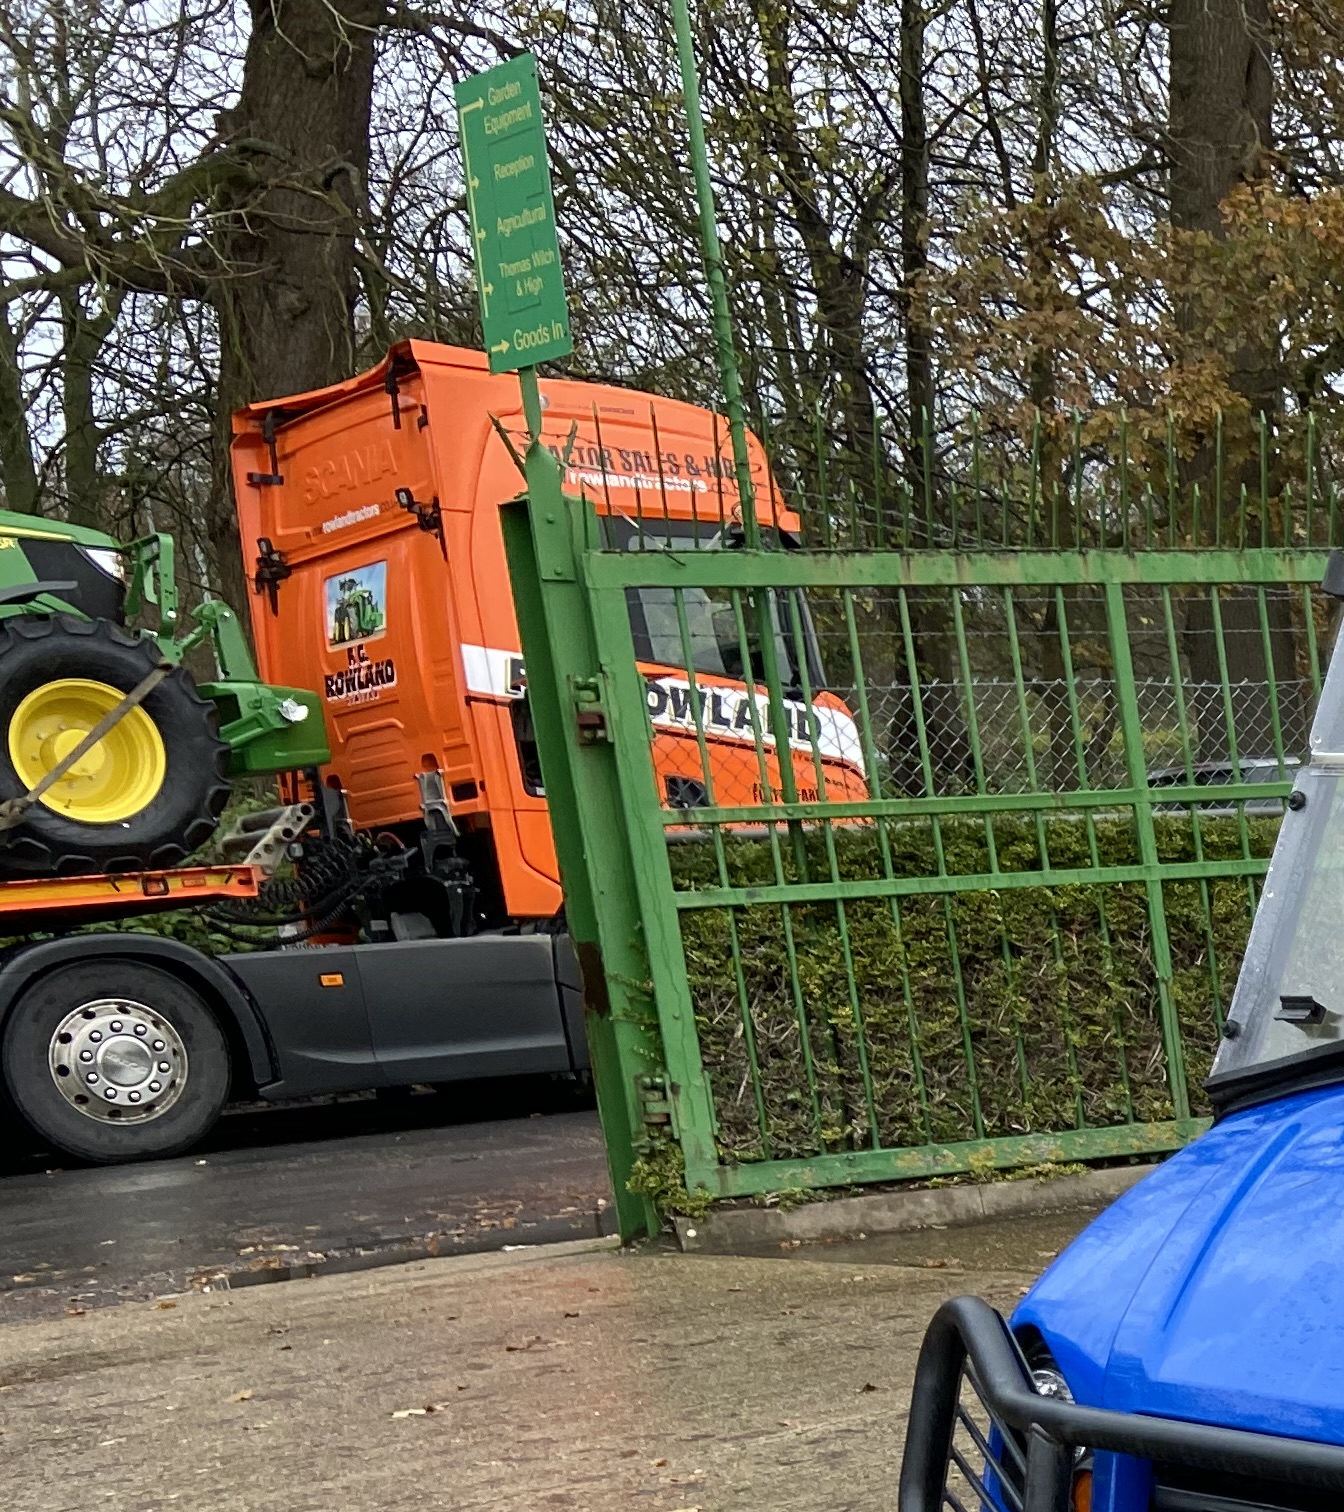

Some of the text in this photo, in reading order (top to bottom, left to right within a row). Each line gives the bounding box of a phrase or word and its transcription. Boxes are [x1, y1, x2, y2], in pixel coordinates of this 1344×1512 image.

[488, 80, 521, 106] Garden
[484, 100, 532, 135] Equipment
[494, 154, 534, 181] Reception
[497, 201, 546, 237] Agricultural
[499, 258, 531, 278] Thomas
[516, 275, 544, 297] & High
[513, 319, 565, 350] Goods In
[304, 438, 398, 506] SCANIA
[619, 450, 680, 475] SALES
[685, 455, 701, 476] &
[325, 659, 397, 699] ROWLAND
